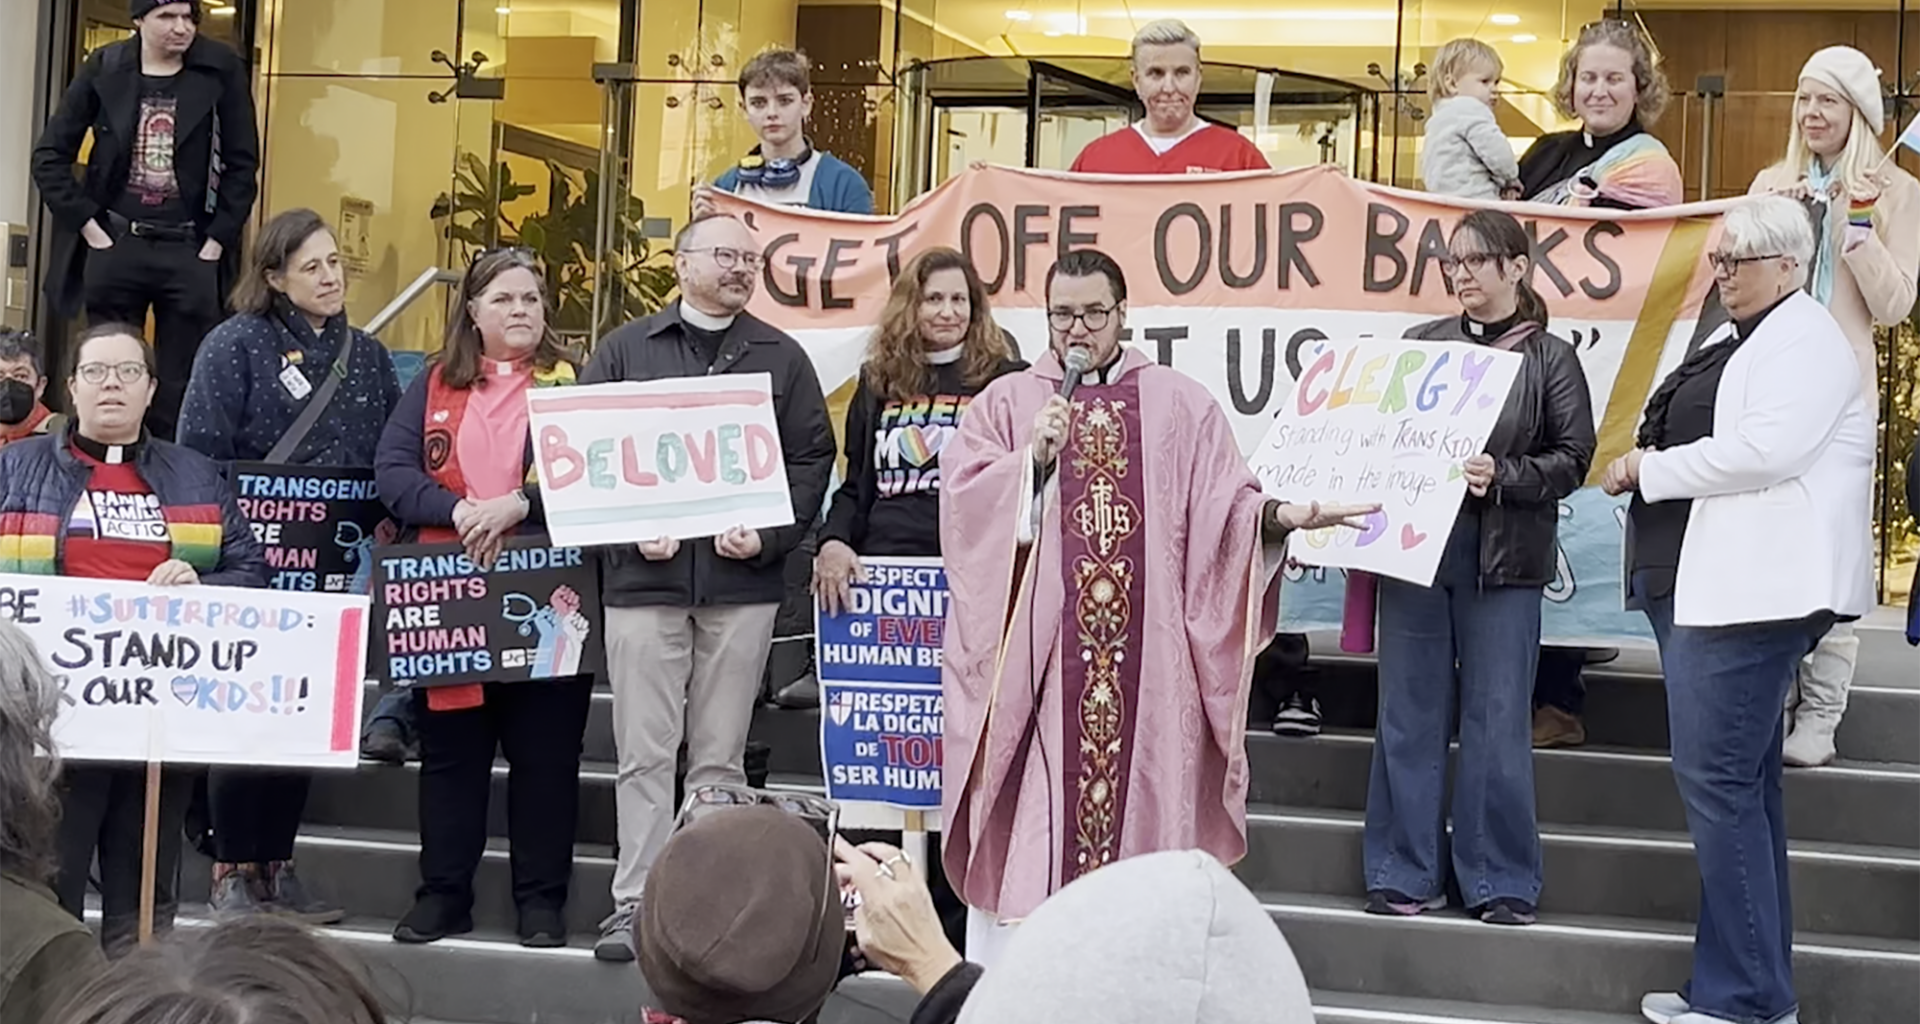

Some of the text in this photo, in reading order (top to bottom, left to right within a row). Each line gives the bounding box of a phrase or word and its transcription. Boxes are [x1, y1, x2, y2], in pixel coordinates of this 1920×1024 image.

[1154, 202, 1324, 296] OUR
[1363, 202, 1625, 301] BAKS
[1271, 420, 1352, 455] Standing
[1360, 429, 1387, 448] with
[540, 423, 779, 490] BELOVED
[1255, 454, 1437, 507] made in the image
[237, 497, 328, 522] RIGHTS
[382, 546, 583, 581] TRANSENDER
[849, 566, 941, 588] ESPECT
[385, 577, 488, 605] RIGHTS
[386, 604, 441, 630] ARE
[388, 625, 487, 654] HUMAN
[849, 616, 945, 648] OF EVE
[51, 627, 258, 672] STAND UP
[823, 643, 913, 667] HUMAN
[390, 650, 493, 679] RIGHTS
[82, 675, 159, 706] OUR
[853, 712, 880, 732] LA
[855, 741, 879, 758] DE
[832, 764, 942, 791] SER HUM
